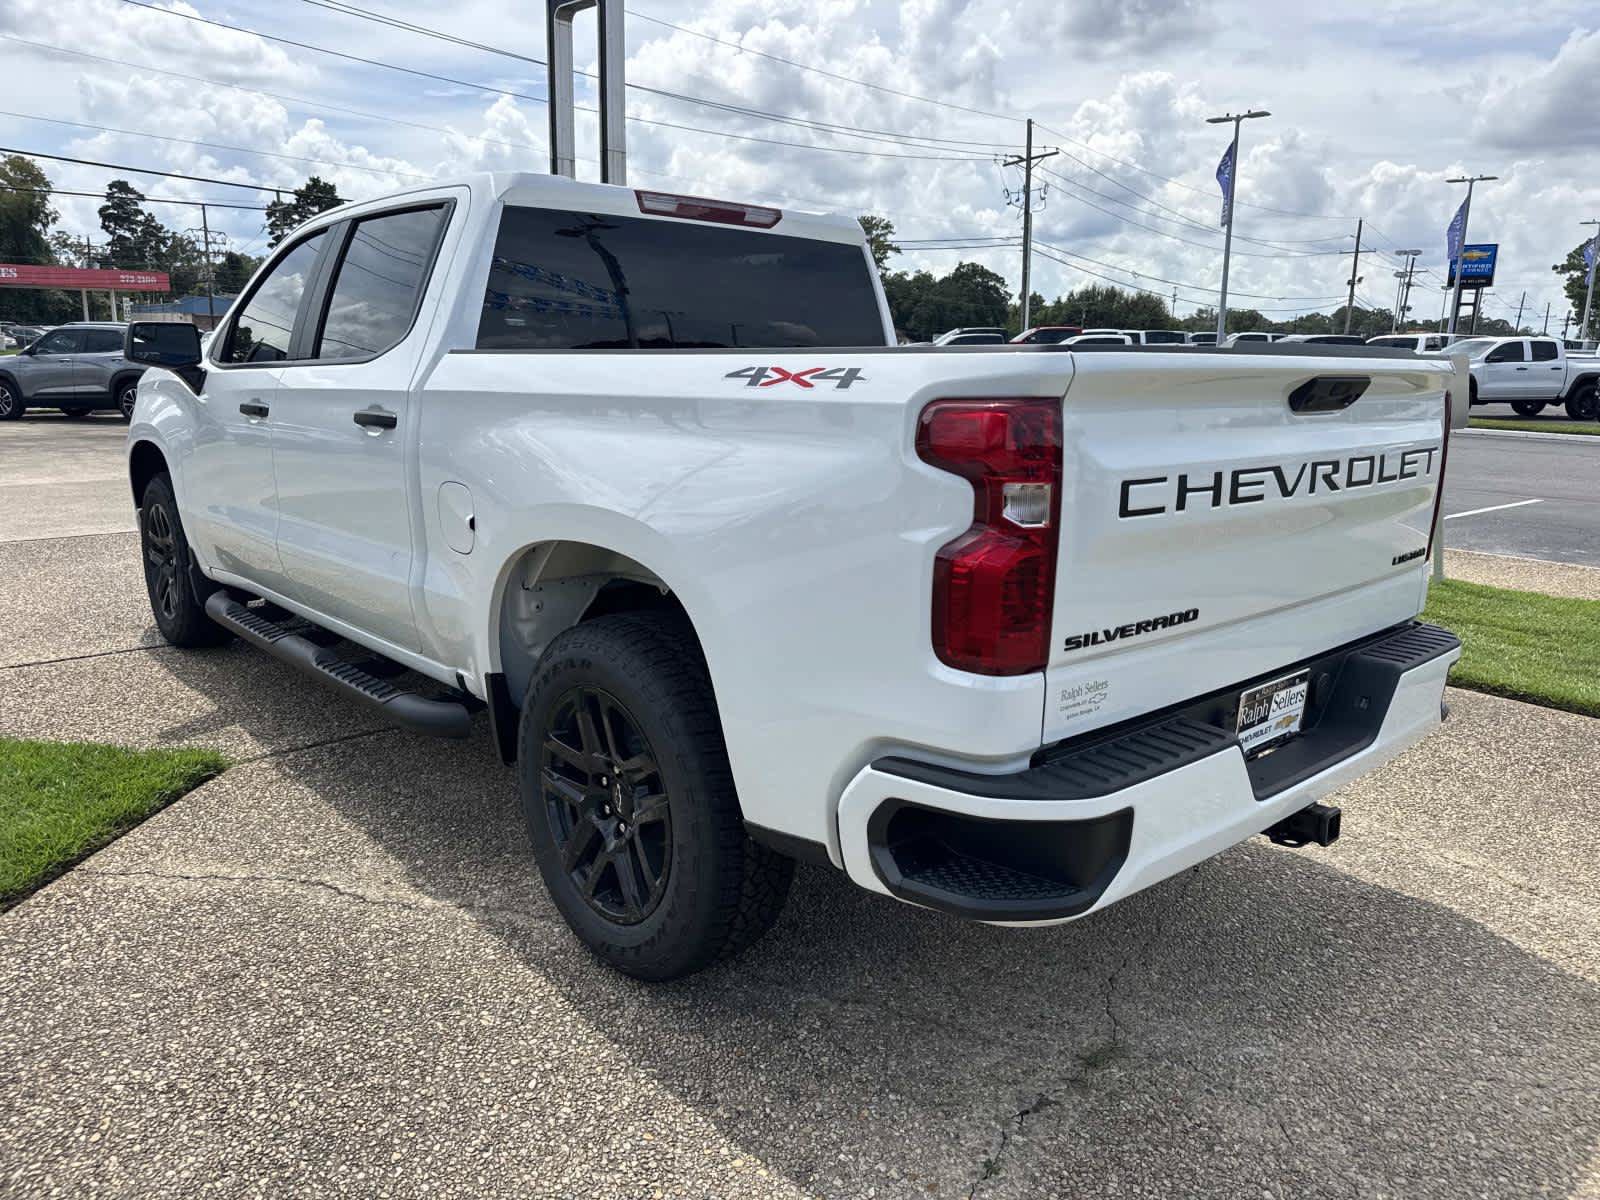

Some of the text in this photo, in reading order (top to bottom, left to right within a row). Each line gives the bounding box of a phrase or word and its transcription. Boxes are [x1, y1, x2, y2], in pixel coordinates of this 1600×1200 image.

[1118, 446, 1439, 518] CHEVROLET
[1064, 607, 1200, 652] SILVERADO
[1240, 699, 1269, 727] Ralph
[1272, 688, 1306, 714] Sellers
